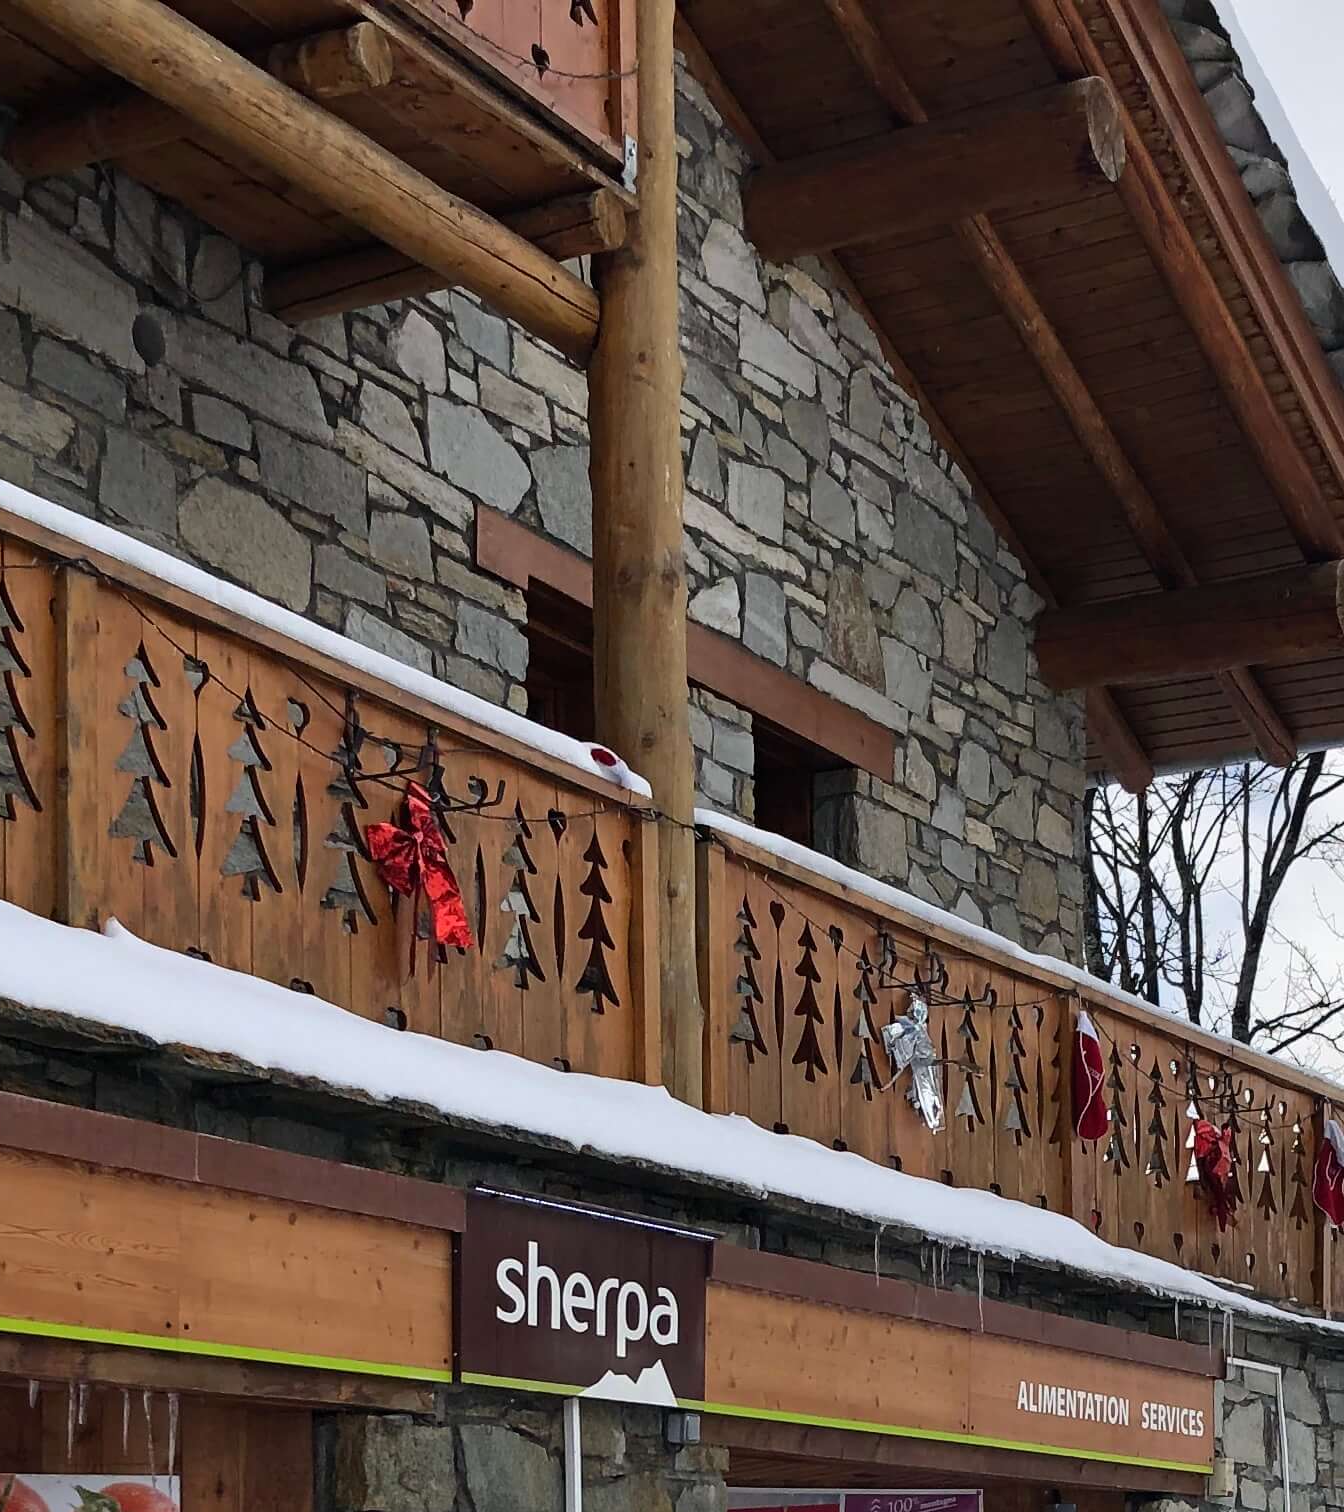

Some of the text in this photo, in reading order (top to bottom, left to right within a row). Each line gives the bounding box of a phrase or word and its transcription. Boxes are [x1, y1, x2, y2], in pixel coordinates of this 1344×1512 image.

[496, 1240, 679, 1358] sherpa
[1016, 1381, 1205, 1437] ALIMENTATION SERVICES
